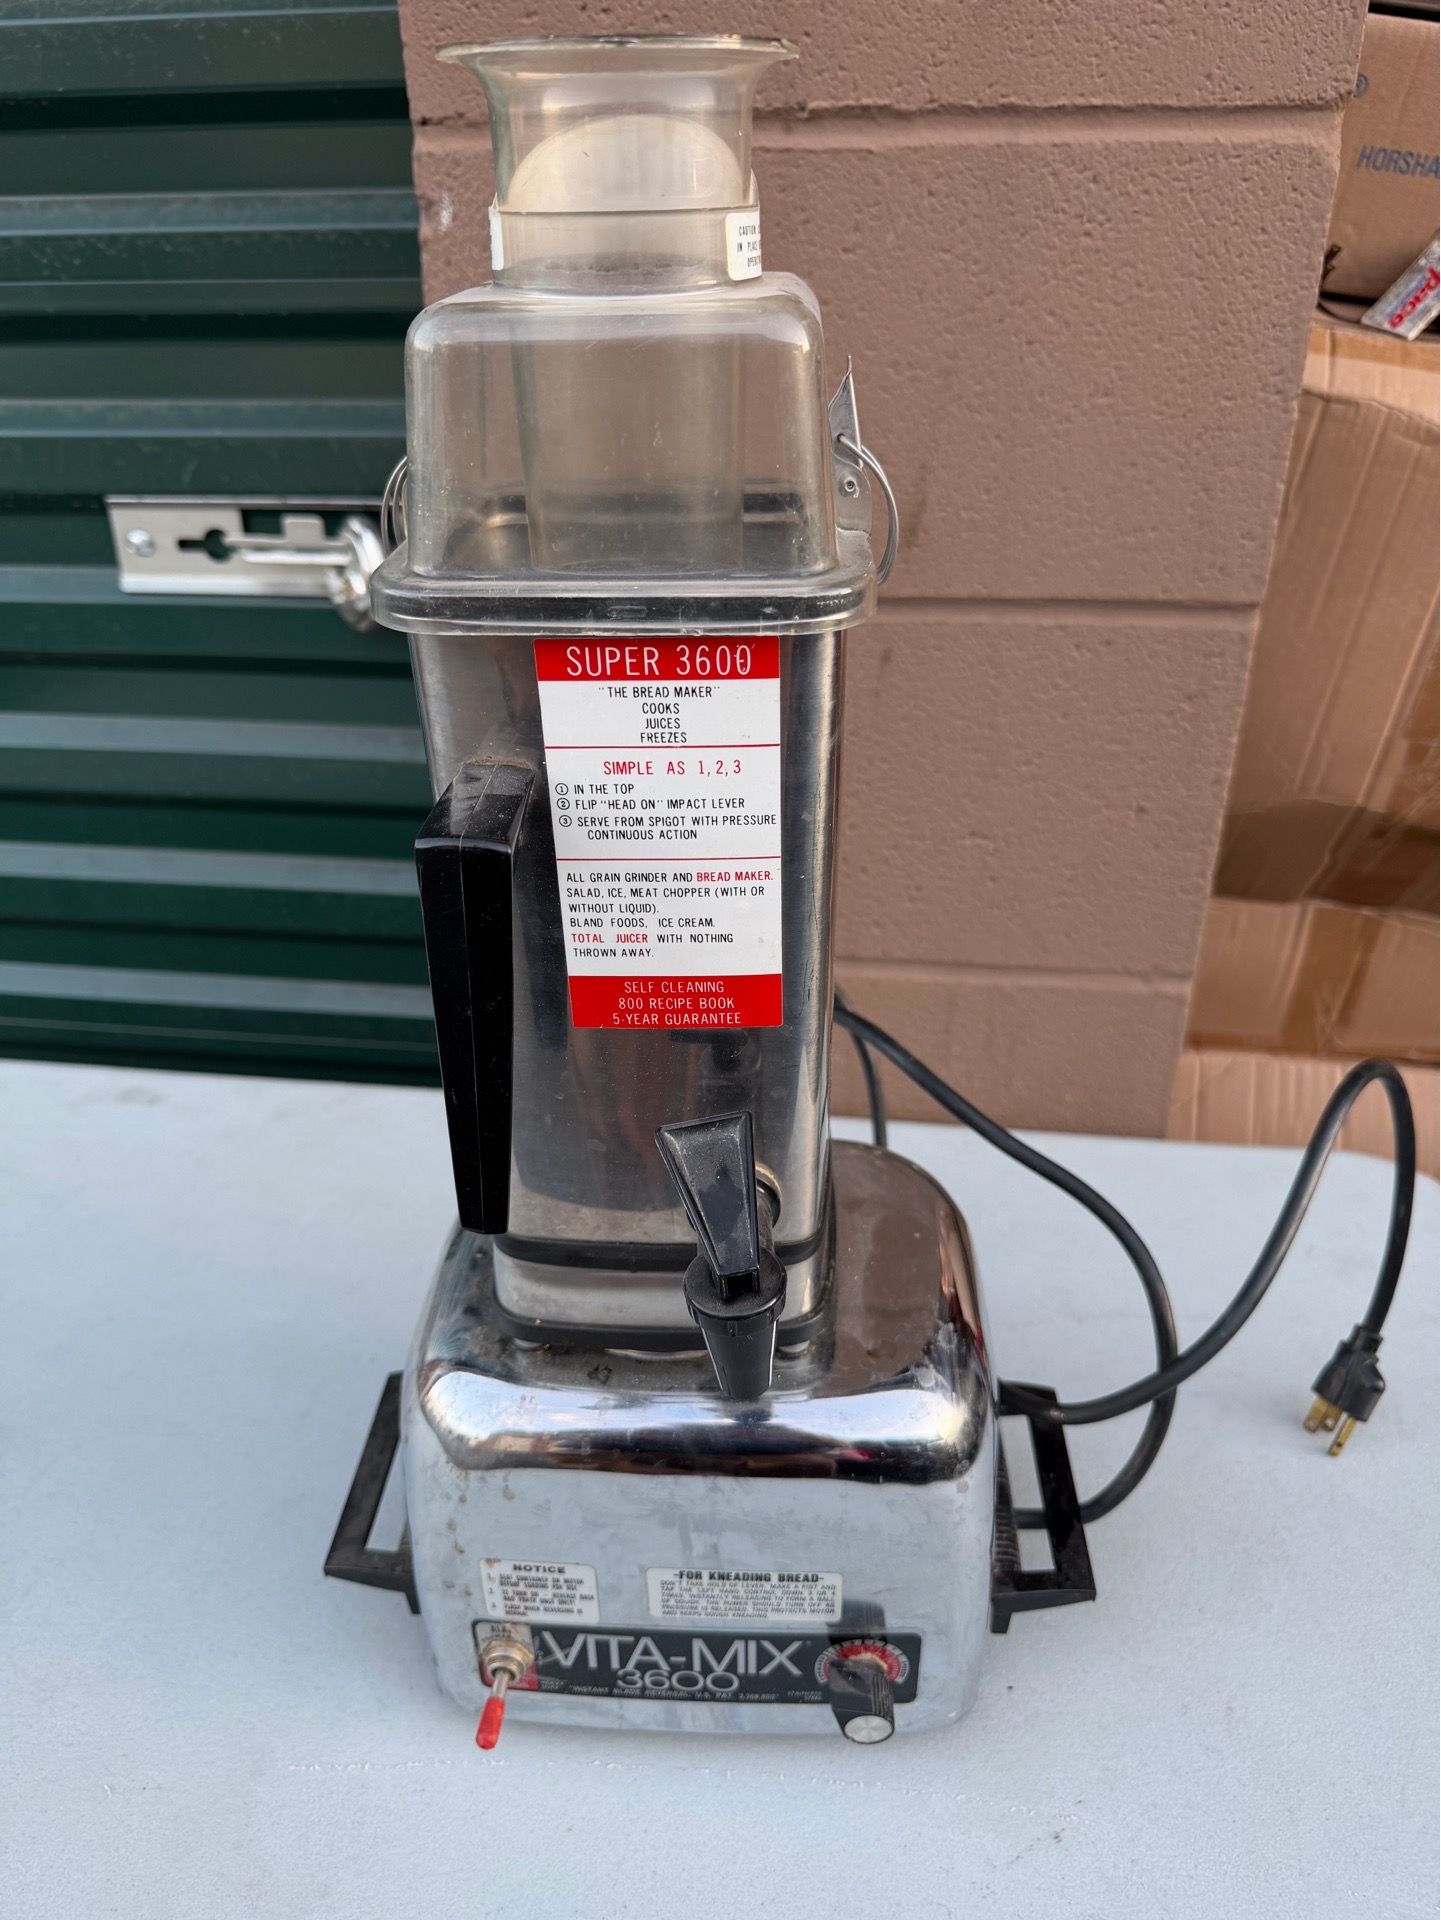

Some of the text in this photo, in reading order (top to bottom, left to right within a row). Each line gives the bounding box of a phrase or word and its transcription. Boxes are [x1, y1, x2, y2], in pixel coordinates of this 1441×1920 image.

[565, 644, 752, 677] SUPER 3600
[632, 685, 670, 698] BREAD
[641, 702, 680, 715] COOKS
[645, 717, 681, 730] JUICES
[640, 731, 688, 744] FREEZES
[603, 760, 654, 776] SIMPLE
[666, 760, 686, 775] AS
[573, 783, 585, 795] IN
[588, 783, 609, 795] THE
[613, 783, 635, 795] TOP
[575, 799, 598, 811] FLIP
[666, 798, 707, 810] IMPACT
[711, 797, 746, 809] LEVER
[577, 816, 610, 828] SERVE
[614, 815, 644, 827] FROM
[648, 815, 686, 827] SPIGOT
[691, 815, 719, 826] WITH
[722, 814, 777, 826] PRESSURE
[587, 829, 698, 840] CONTINUOUS ACTION
[566, 870, 774, 883] ALL GRAIN GRINDER AND BREAD MAKER.
[566, 887, 605, 899] SALAD,
[629, 887, 658, 898] MEAT
[662, 886, 711, 898] CHOPPER
[714, 886, 747, 898] (WITH
[750, 886, 765, 896] OR
[568, 903, 660, 915] WITHOUT LIQUID).
[570, 917, 716, 929] BLAND FOODS, ICE CREAM.
[570, 933, 734, 944] TOTAL JUICER WITH NOTHING
[573, 947, 655, 958] THROWN AWAY.
[623, 981, 725, 994] SELF CLEANING
[618, 997, 735, 1010] 800 RECIPE BOOK
[612, 1012, 742, 1025] 5-YEAR GUARANTEE
[513, 1564, 566, 1573] NOTICE
[708, 1571, 771, 1582] KNEADING
[541, 1630, 804, 1676] VITA-MIX
[615, 1667, 741, 1694] 3600
